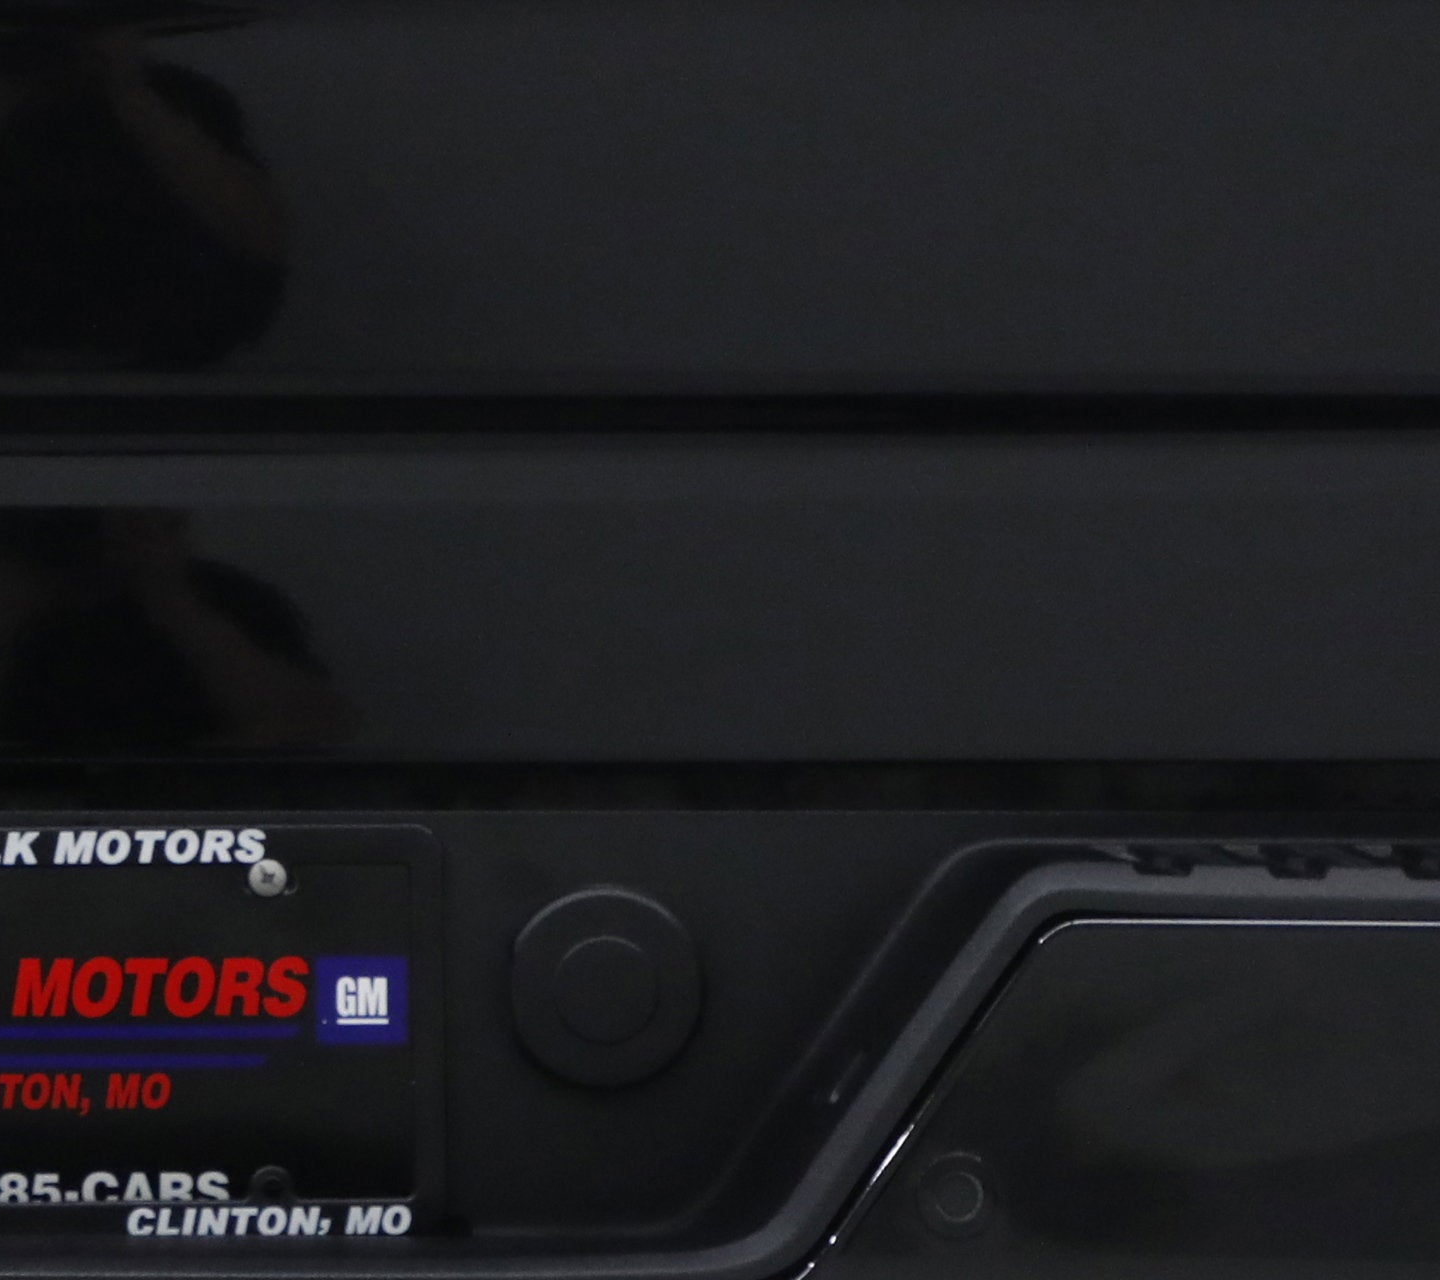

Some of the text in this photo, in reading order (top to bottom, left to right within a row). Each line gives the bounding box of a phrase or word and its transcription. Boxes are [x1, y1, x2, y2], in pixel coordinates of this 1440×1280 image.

[53, 829, 267, 865] MOTORS
[12, 956, 310, 1018] MOTORS
[336, 976, 388, 1018] GM
[106, 1073, 171, 1110] MO
[127, 1205, 413, 1237] CLINTON, MO
